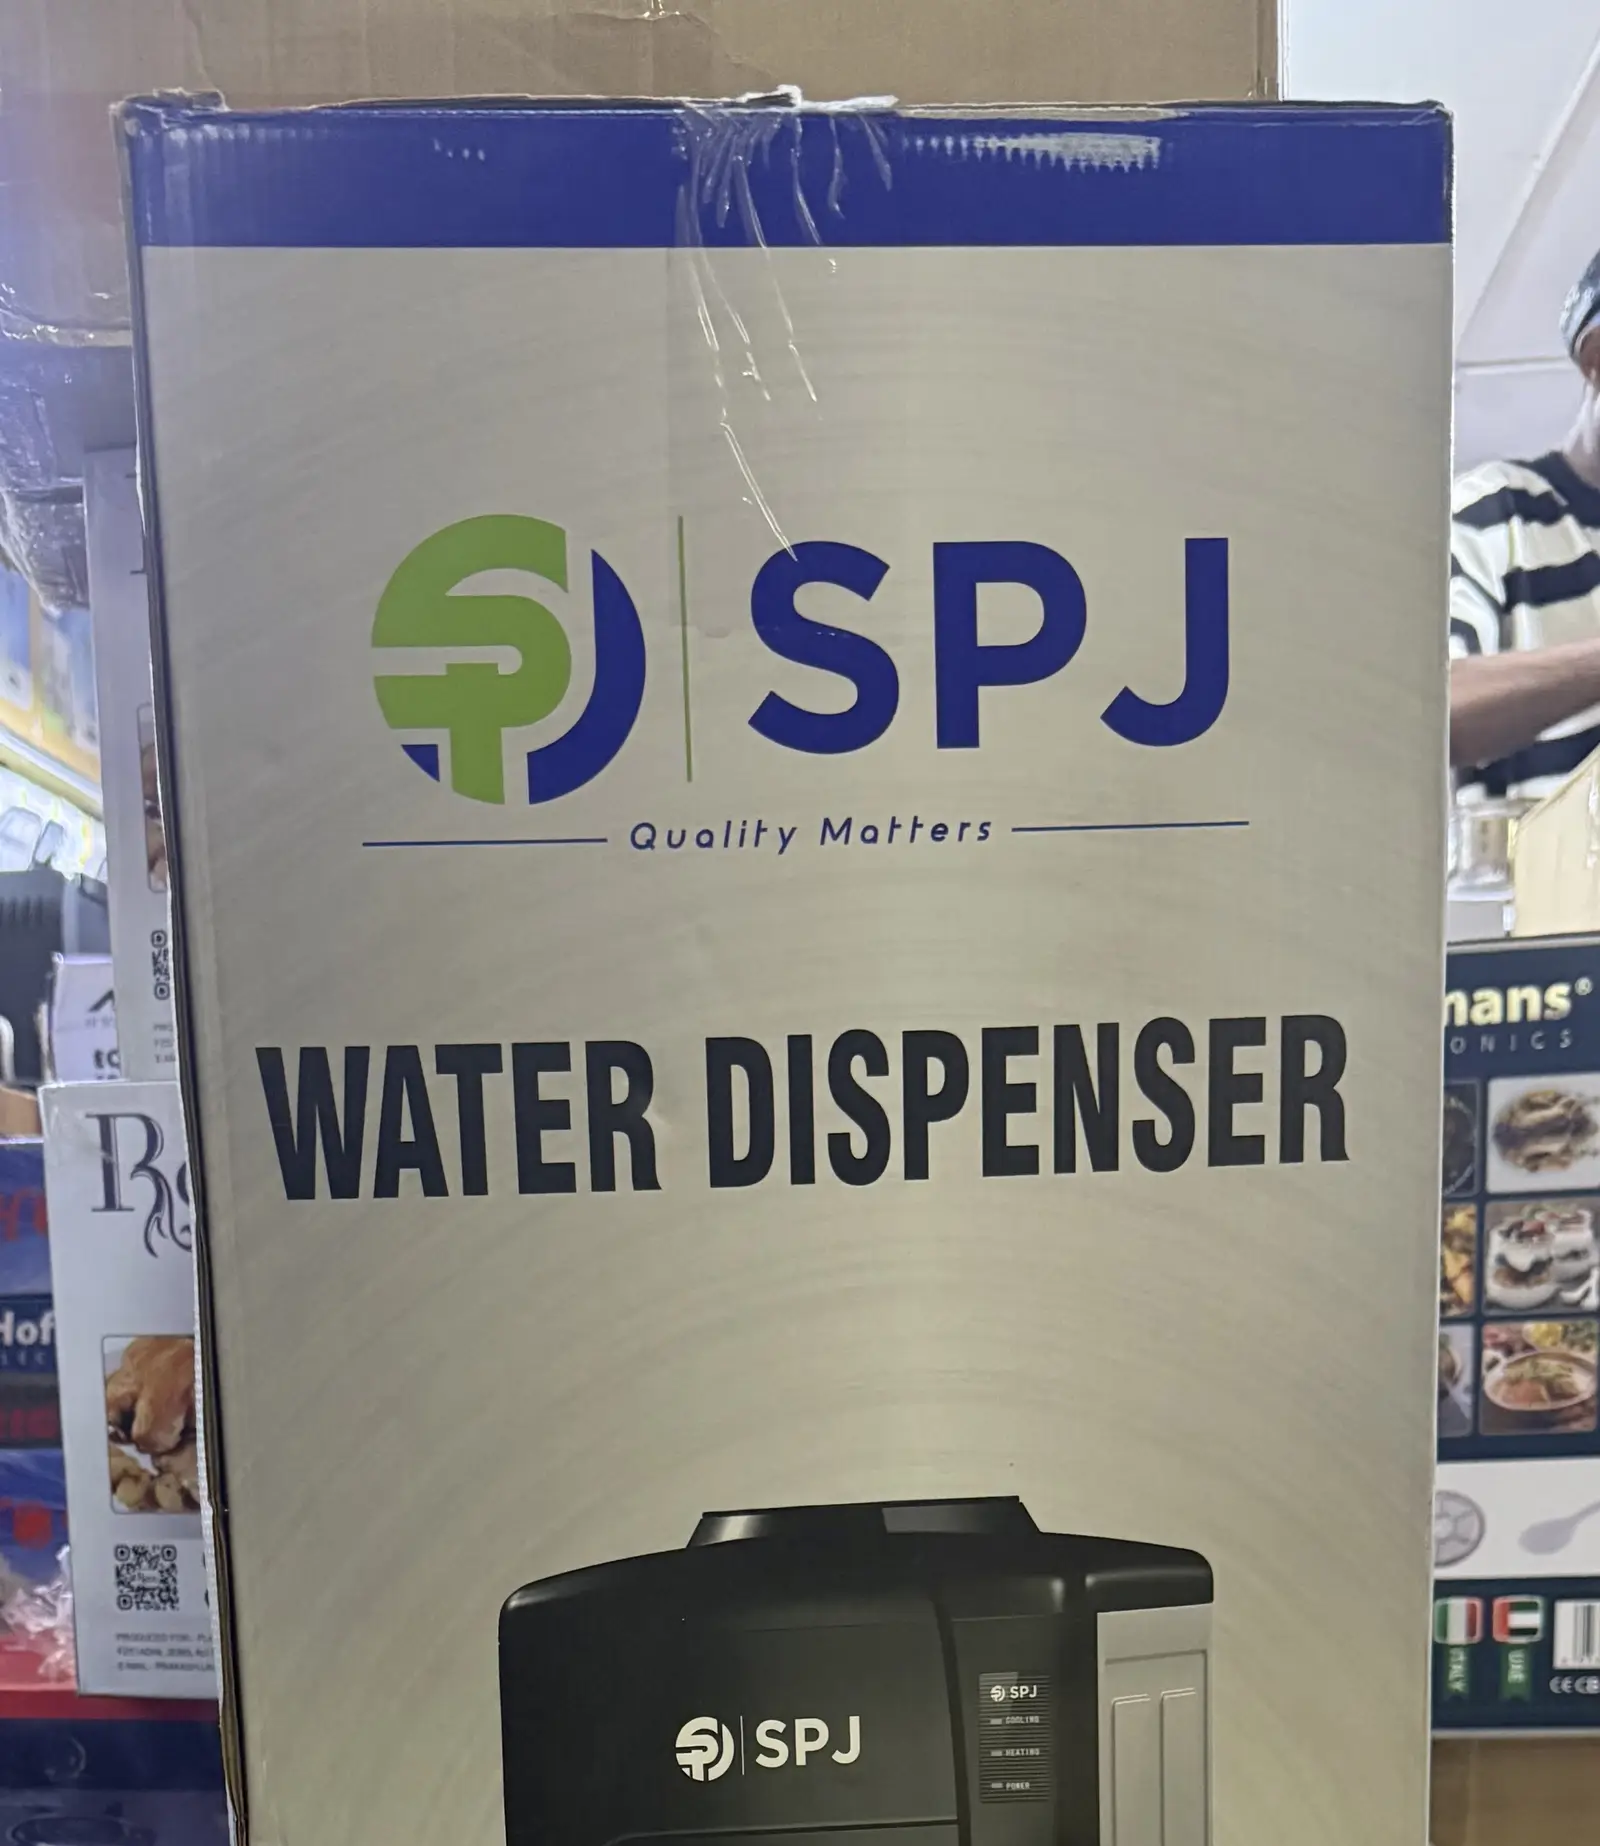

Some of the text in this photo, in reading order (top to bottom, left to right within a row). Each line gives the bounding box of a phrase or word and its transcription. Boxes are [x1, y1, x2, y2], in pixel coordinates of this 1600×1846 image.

[748, 538, 1229, 754] SPJ
[630, 816, 991, 855] Quality Matters
[255, 1014, 1351, 1199] WATER DISPENSER
[1009, 1685, 1038, 1699] SPJ
[1005, 1715, 1040, 1724] COOLING
[755, 1716, 860, 1768] SPJ
[1005, 1748, 1040, 1757] HEATING
[1005, 1782, 1030, 1791] POWER
